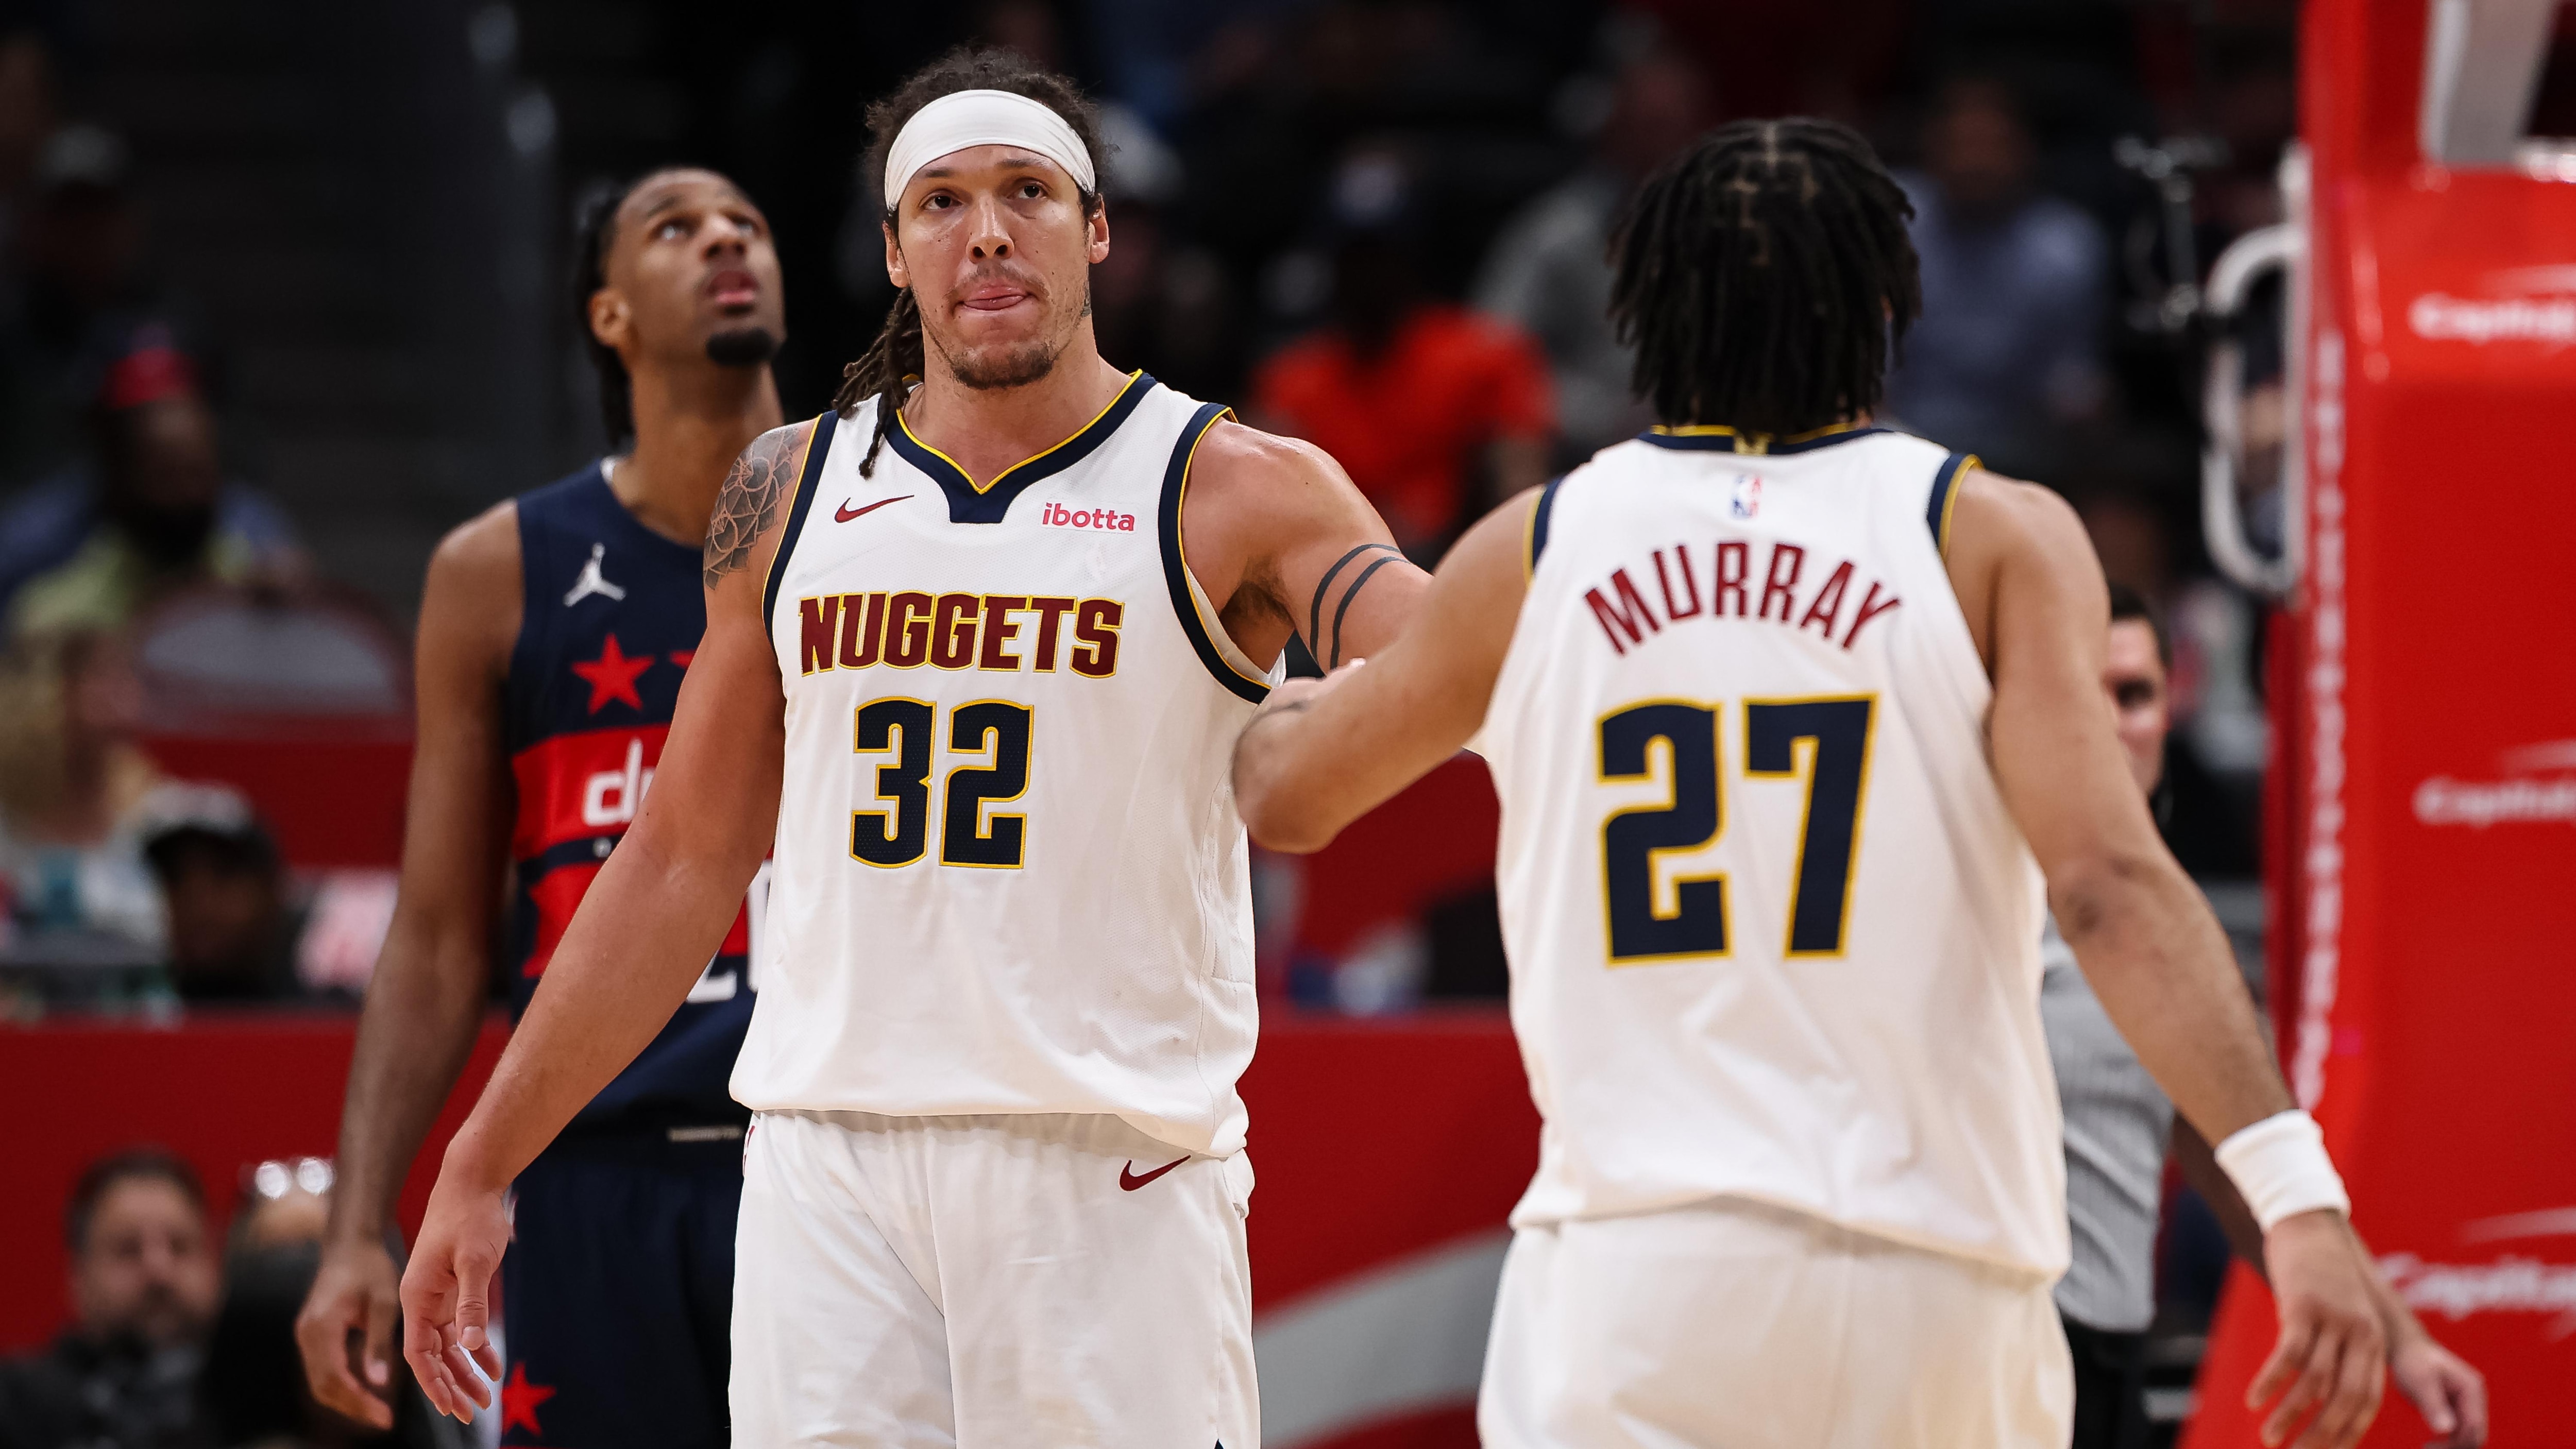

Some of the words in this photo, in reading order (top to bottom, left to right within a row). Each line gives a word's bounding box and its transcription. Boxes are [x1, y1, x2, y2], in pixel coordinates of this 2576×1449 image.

[1042, 502, 1135, 531] ibotta
[799, 590, 1125, 679] NUGGETS
[1584, 541, 1901, 657] MURRAY
[849, 696, 1035, 869] 32
[1593, 690, 1880, 969] 27
